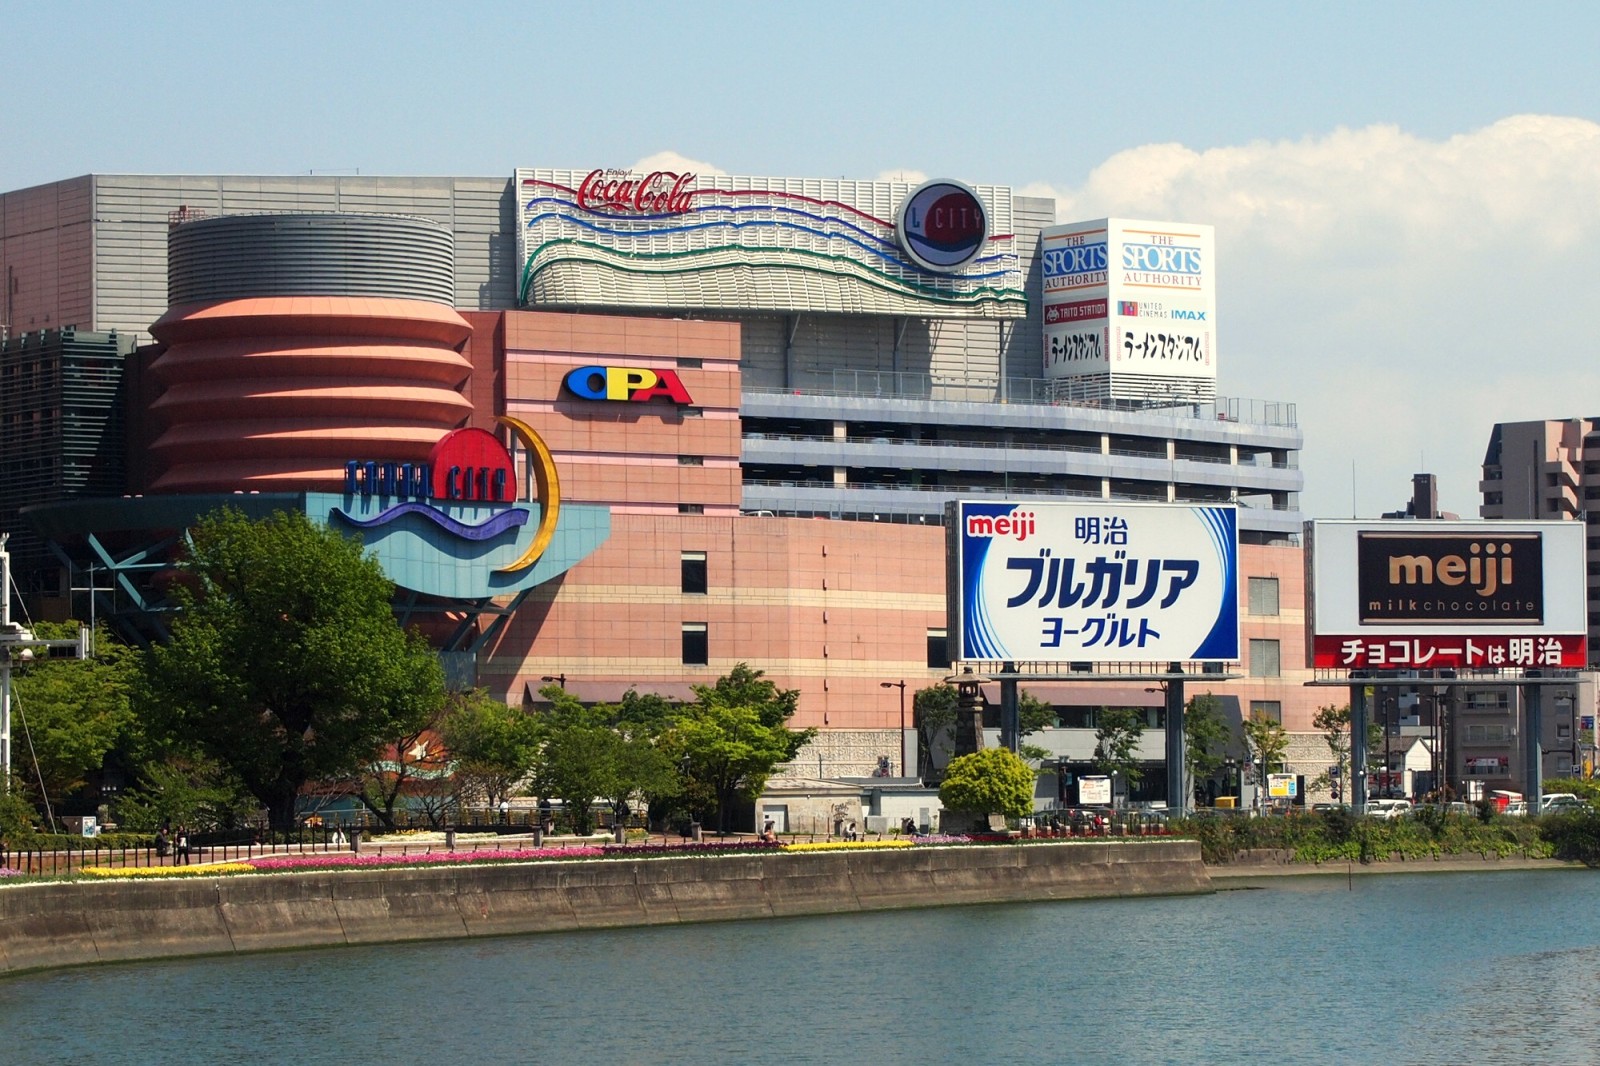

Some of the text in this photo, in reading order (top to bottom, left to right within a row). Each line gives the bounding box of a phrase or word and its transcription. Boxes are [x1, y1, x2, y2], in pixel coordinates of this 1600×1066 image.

[577, 169, 698, 214] Coca-Cola
[935, 207, 980, 229] CITY
[1066, 236, 1085, 246] THE
[1151, 236, 1174, 245] THE
[1044, 245, 1107, 276] SPORTS
[1123, 245, 1201, 273] SPORTS
[1045, 271, 1108, 288] AUTHORITY
[1124, 273, 1201, 286] AUTHORITY
[1060, 304, 1105, 318] TAITO STATION
[1139, 302, 1162, 310] UNITED
[1139, 310, 1168, 318] CINEMAS
[1171, 310, 1206, 320] IMAX
[1124, 332, 1203, 361] ラーメンスタジアム
[563, 366, 694, 404] OPA
[969, 512, 1035, 541] meiji
[1074, 517, 1128, 545] 明治
[1006, 548, 1200, 609] ブルガリア
[1389, 543, 1512, 597] meiji
[1040, 613, 1160, 648] ヨーグルト
[1341, 638, 1563, 665] チョコレートは明治
